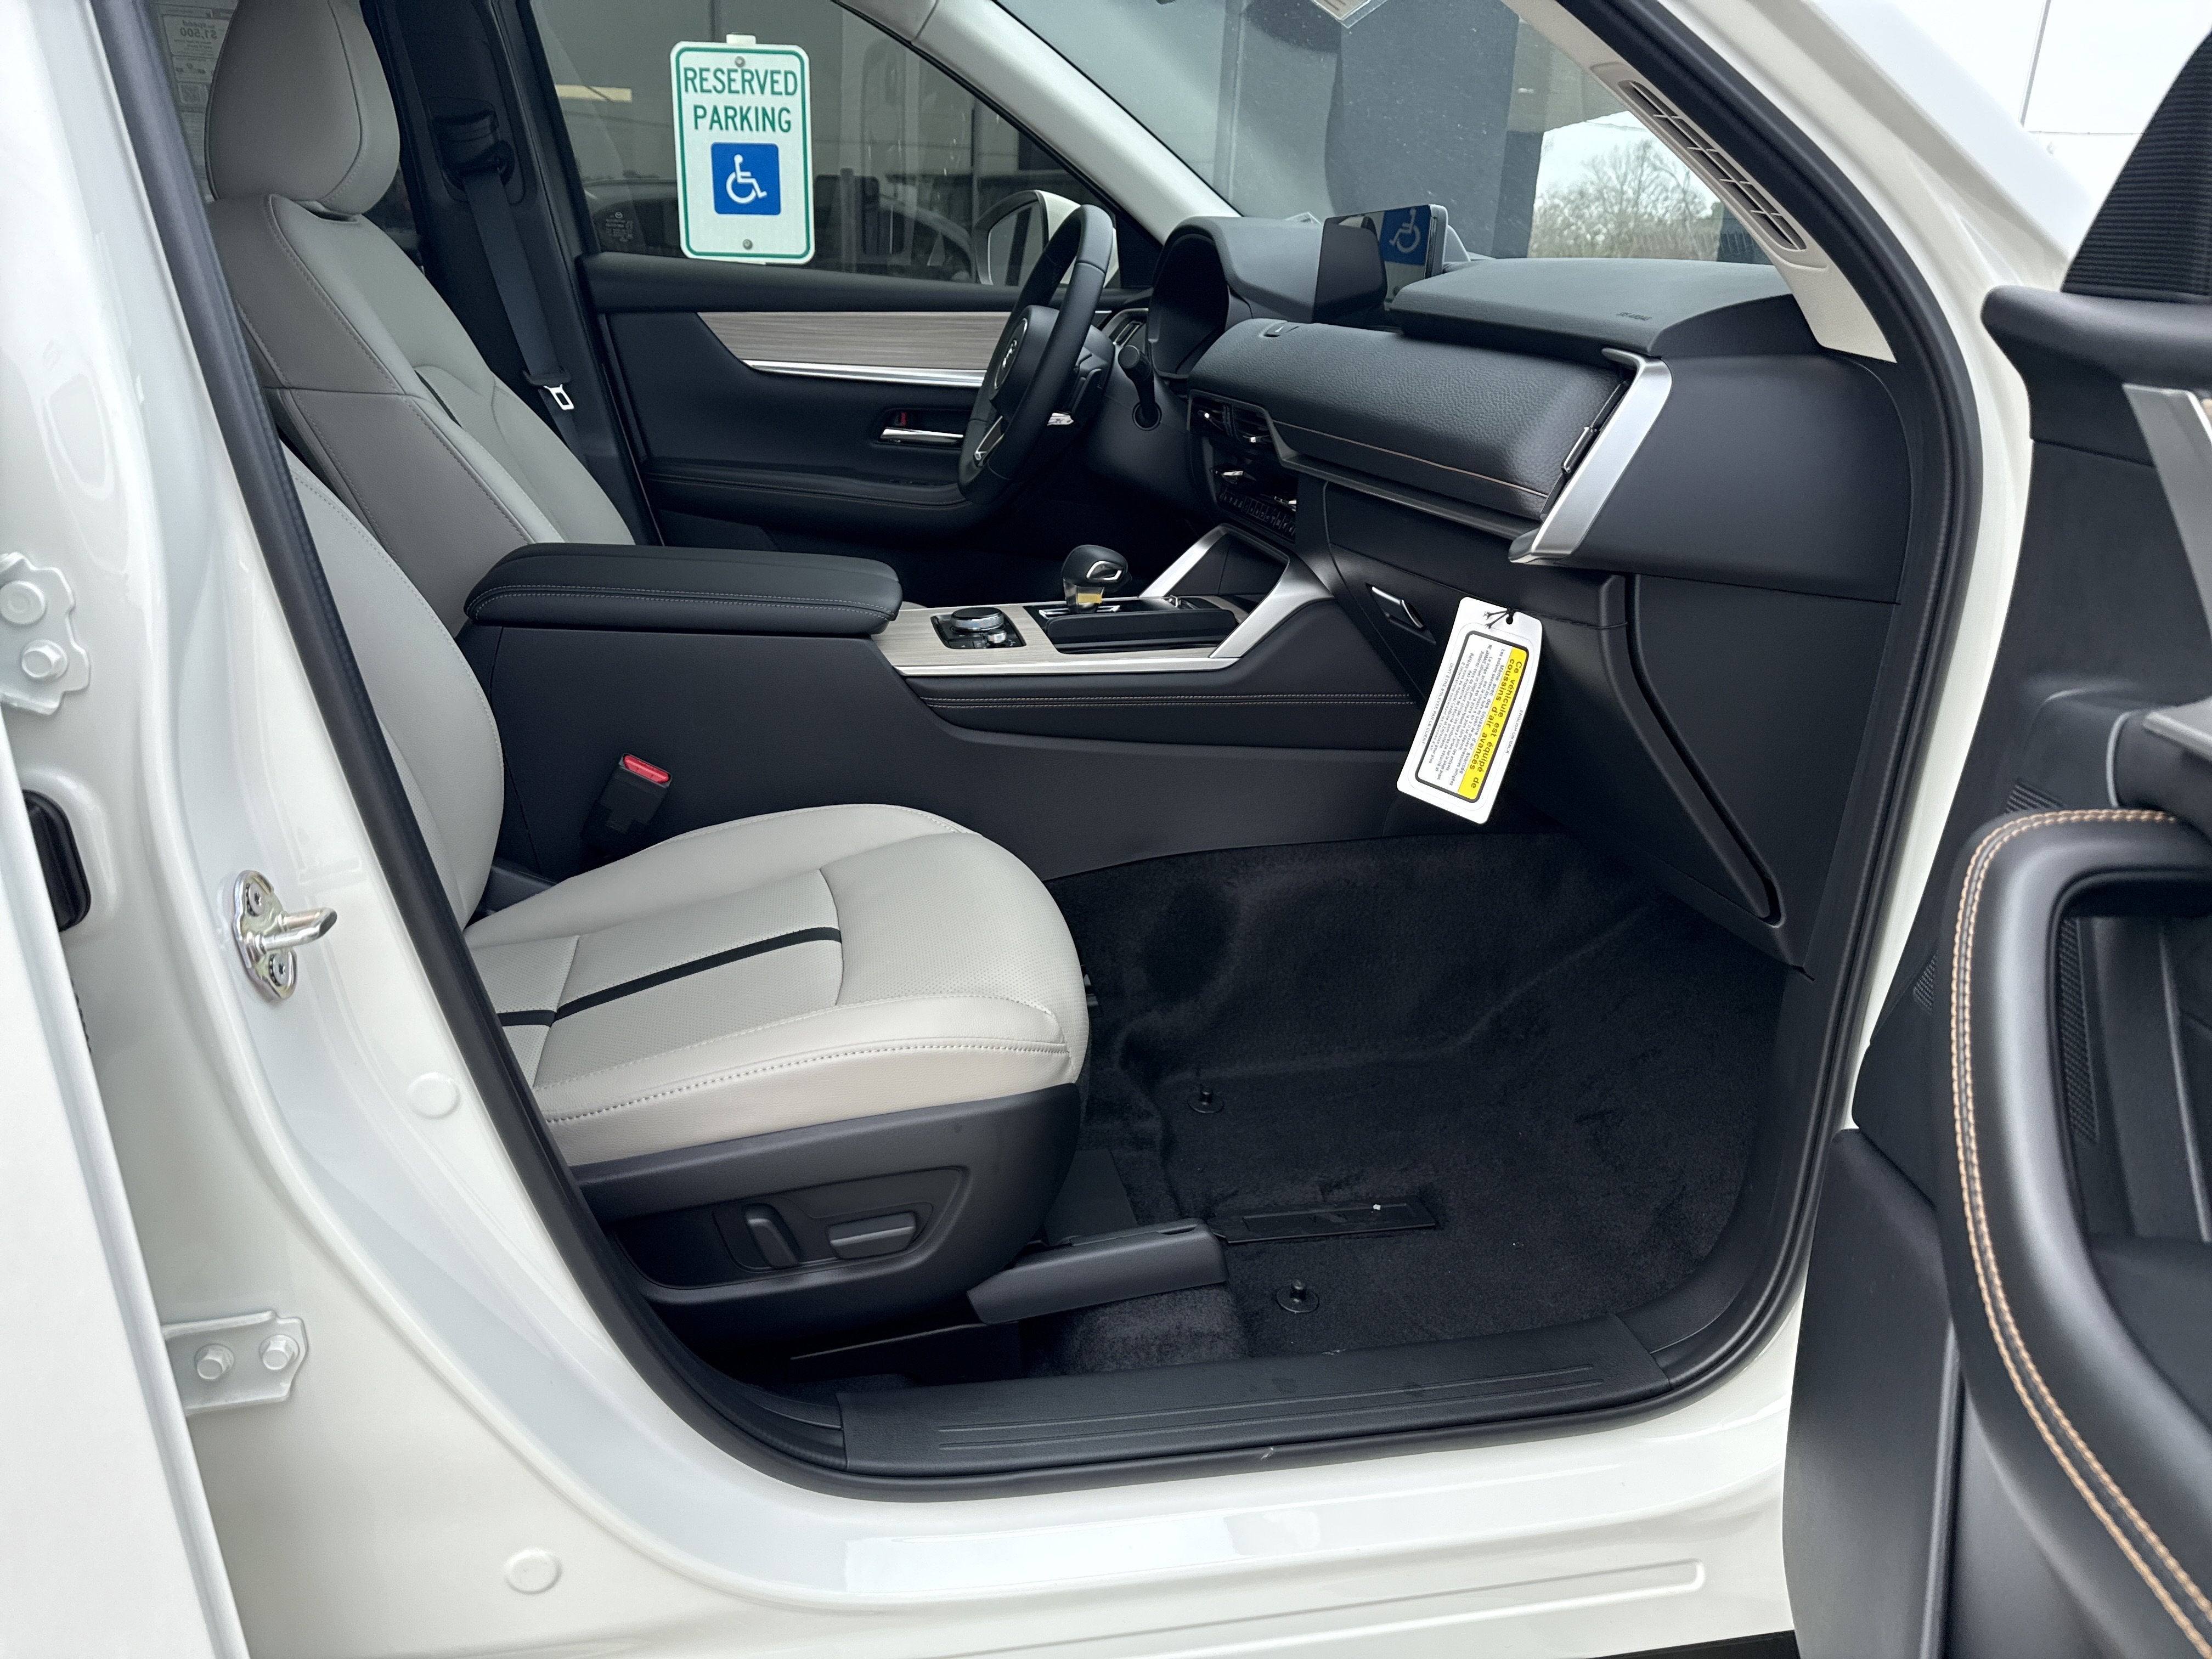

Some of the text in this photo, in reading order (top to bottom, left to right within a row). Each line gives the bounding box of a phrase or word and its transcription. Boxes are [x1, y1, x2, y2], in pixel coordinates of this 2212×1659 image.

[684, 67, 798, 96] RESERVED
[693, 104, 791, 133] PARKING
[1469, 658, 1515, 770] coussins d'air avancés
[1471, 661, 1522, 788] Ce véhicule est équipé de
[1474, 711, 1486, 735] coussins
[1514, 709, 1523, 731] ENGLISH
[1421, 727, 1430, 744] CLIENT
